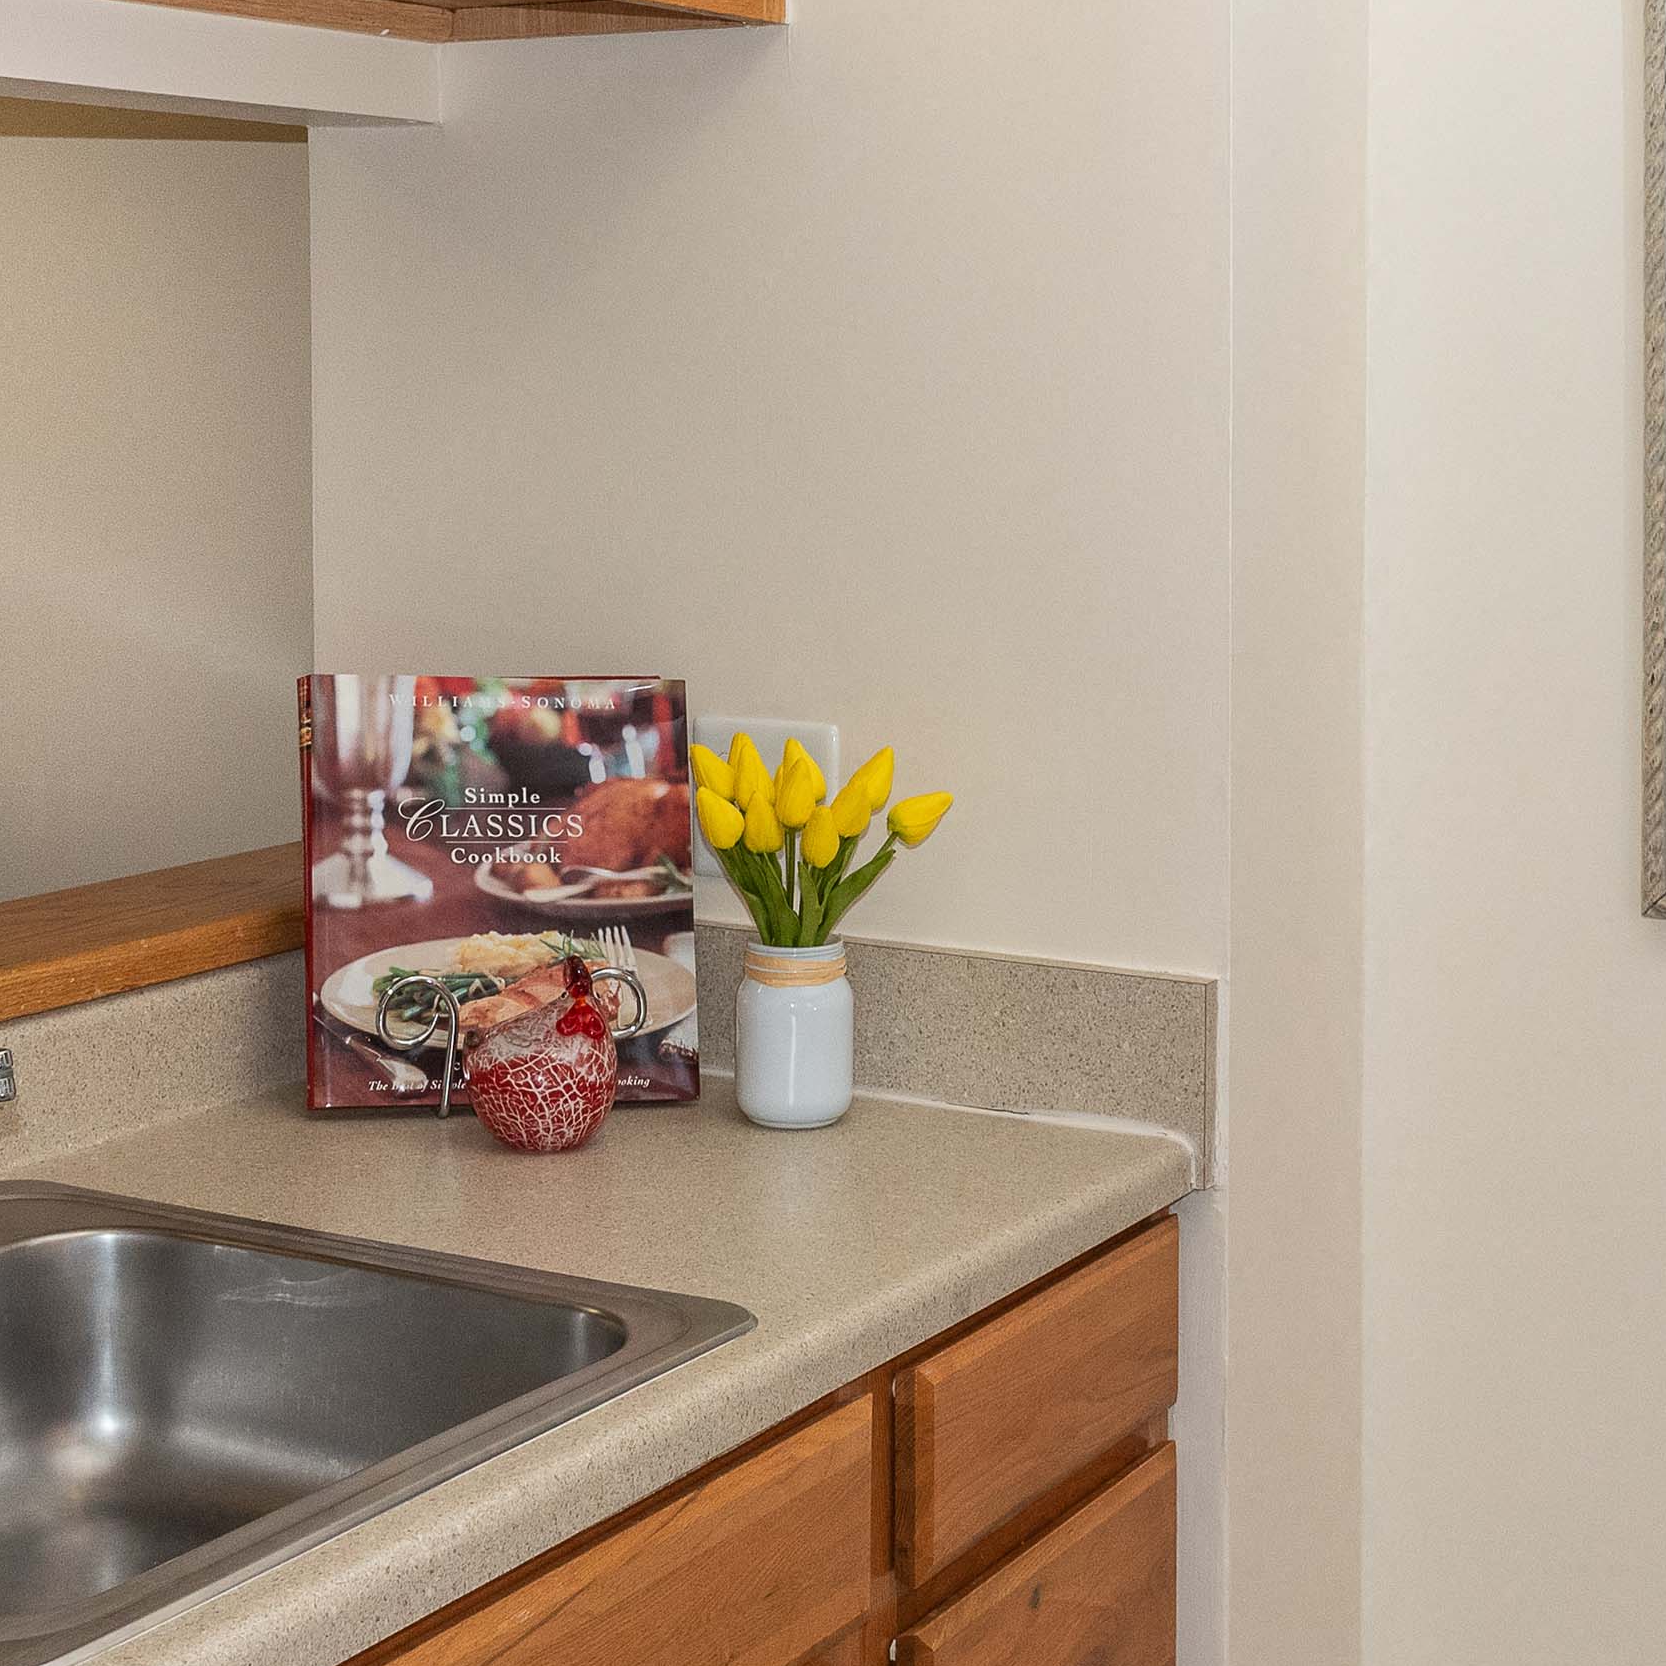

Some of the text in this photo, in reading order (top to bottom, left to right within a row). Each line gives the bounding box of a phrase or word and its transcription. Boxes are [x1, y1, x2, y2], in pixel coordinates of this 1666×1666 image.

[464, 787, 541, 808] Simple
[398, 797, 584, 842] CLASSICS
[450, 847, 562, 864] Cookbook
[368, 1080, 388, 1091] The
